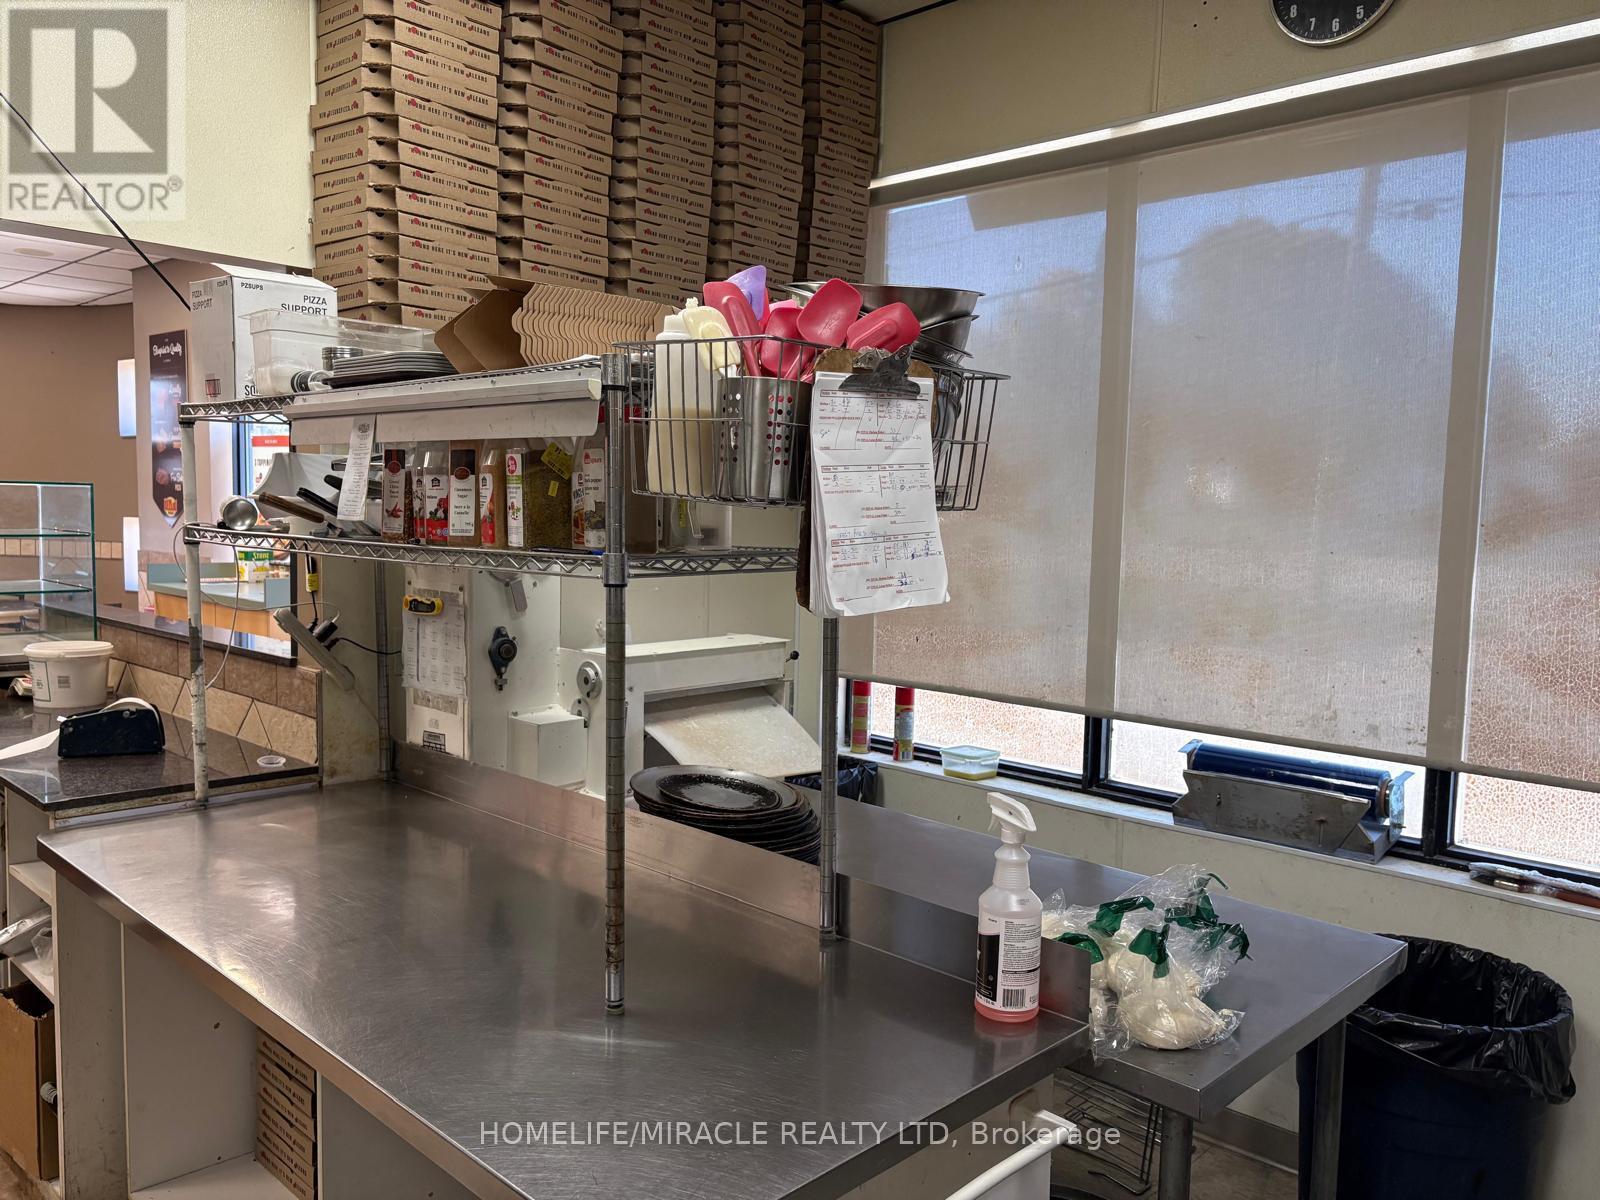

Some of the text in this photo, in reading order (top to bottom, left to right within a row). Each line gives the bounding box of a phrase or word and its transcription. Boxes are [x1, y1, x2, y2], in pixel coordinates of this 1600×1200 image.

[1290, 5, 1297, 18] 8
[1356, 6, 1364, 19] 5
[427, 10, 441, 19] HERE
[455, 20, 467, 28] NEW
[1310, 18, 1316, 31] 7
[1332, 19, 1340, 32] 6
[428, 35, 442, 43] HERE
[456, 44, 468, 52] NEW
[425, 58, 439, 66] HERE
[425, 81, 439, 89] HERE
[427, 106, 441, 115] HERE
[431, 130, 444, 139] HERE
[430, 154, 443, 162] HERE
[240, 282, 264, 291] PZSUPS
[193, 298, 212, 311] SUPPORT
[303, 295, 327, 306] PIZZA
[281, 303, 327, 316] SUPPORT
